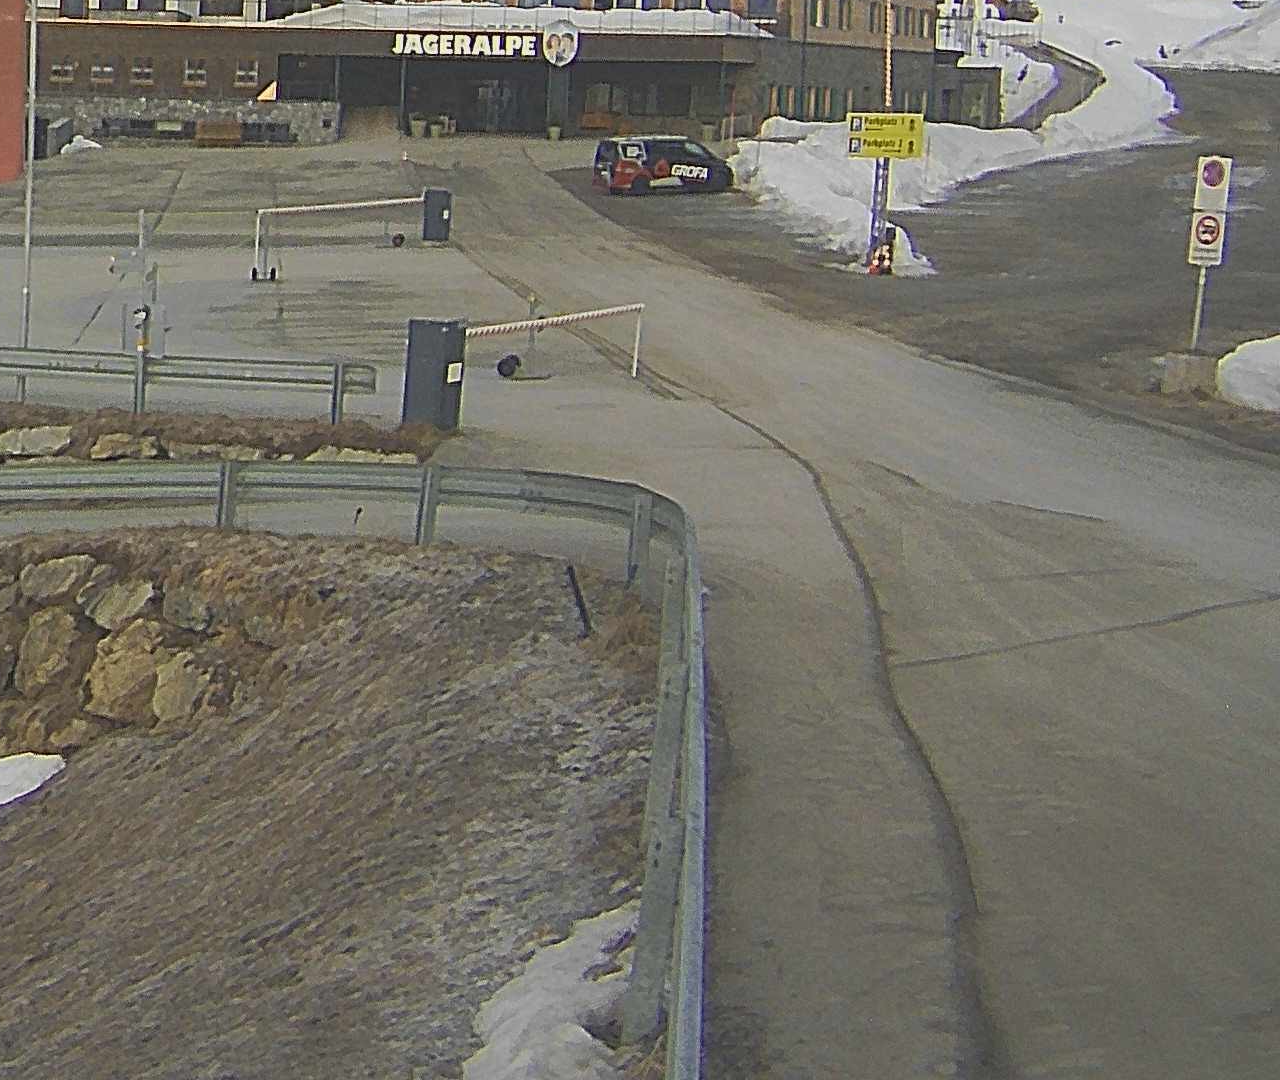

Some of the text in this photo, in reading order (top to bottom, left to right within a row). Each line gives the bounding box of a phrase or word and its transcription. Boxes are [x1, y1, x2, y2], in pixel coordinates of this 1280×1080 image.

[864, 116, 898, 126] Parkplatz
[862, 138, 896, 148] Parkplatz
[671, 164, 709, 178] GROFA
